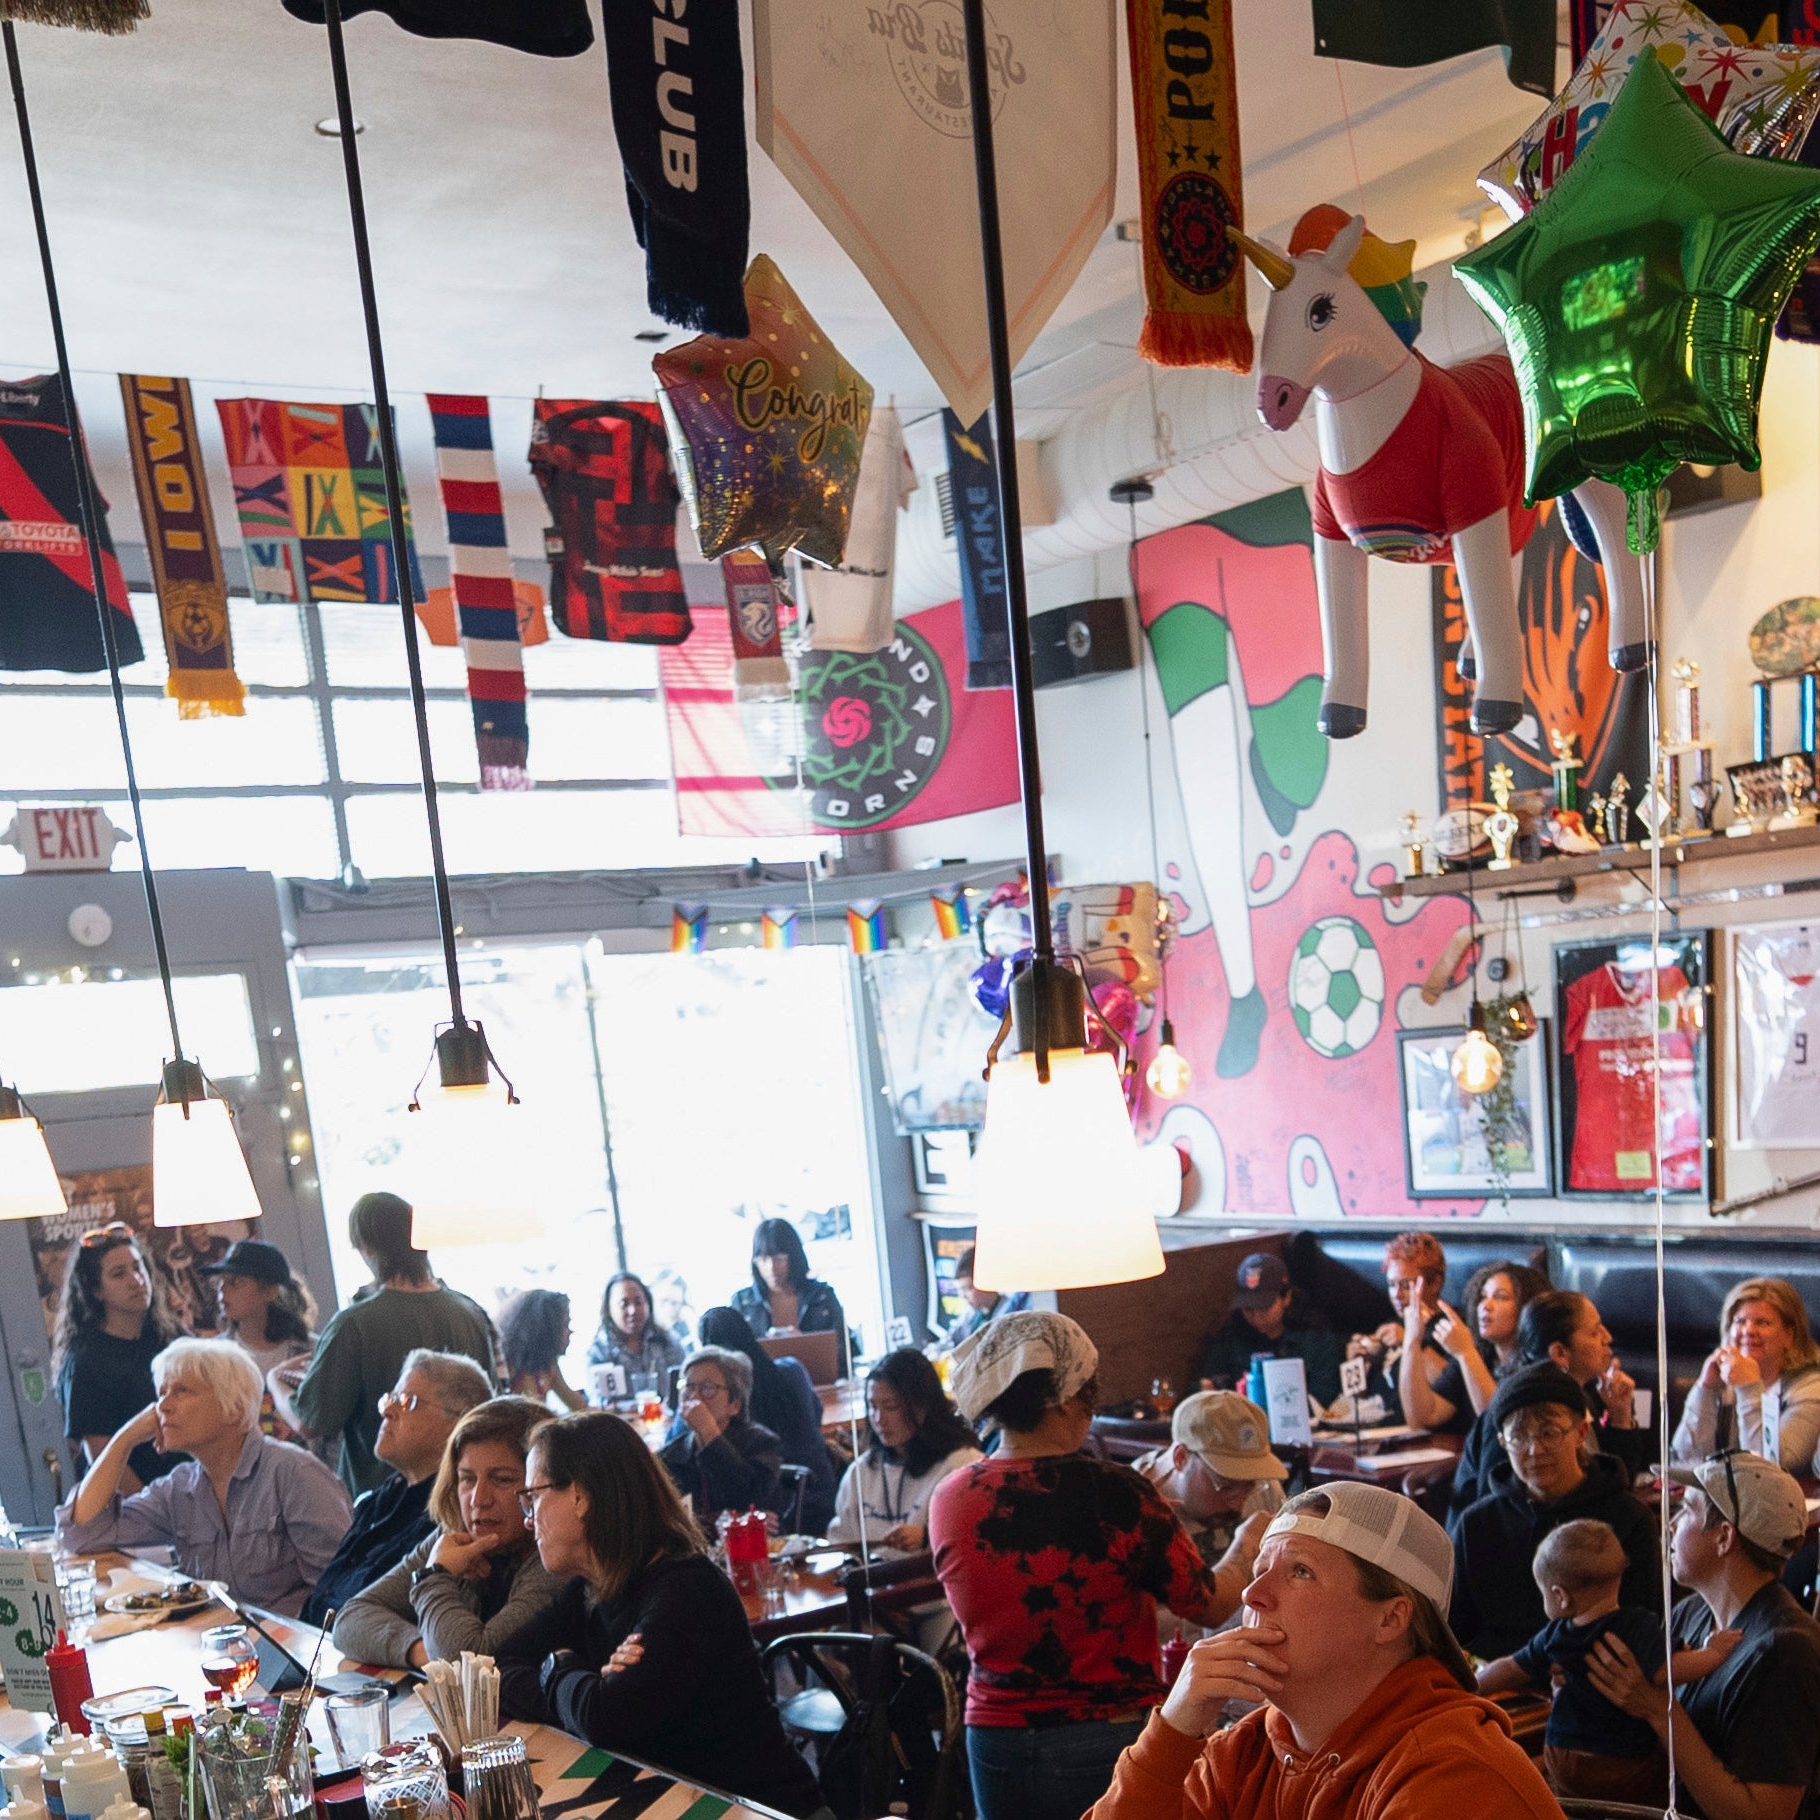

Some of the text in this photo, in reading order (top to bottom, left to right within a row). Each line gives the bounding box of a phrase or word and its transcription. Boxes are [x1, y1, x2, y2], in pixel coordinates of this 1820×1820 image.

[11, 521, 79, 540] TOYOTA
[33, 808, 99, 860] EXIT
[1793, 1031, 1808, 1066] 9
[43, 1201, 118, 1228] WOMEN'S
[5, 1577, 25, 1586] HOUR
[32, 1590, 56, 1635] 14
